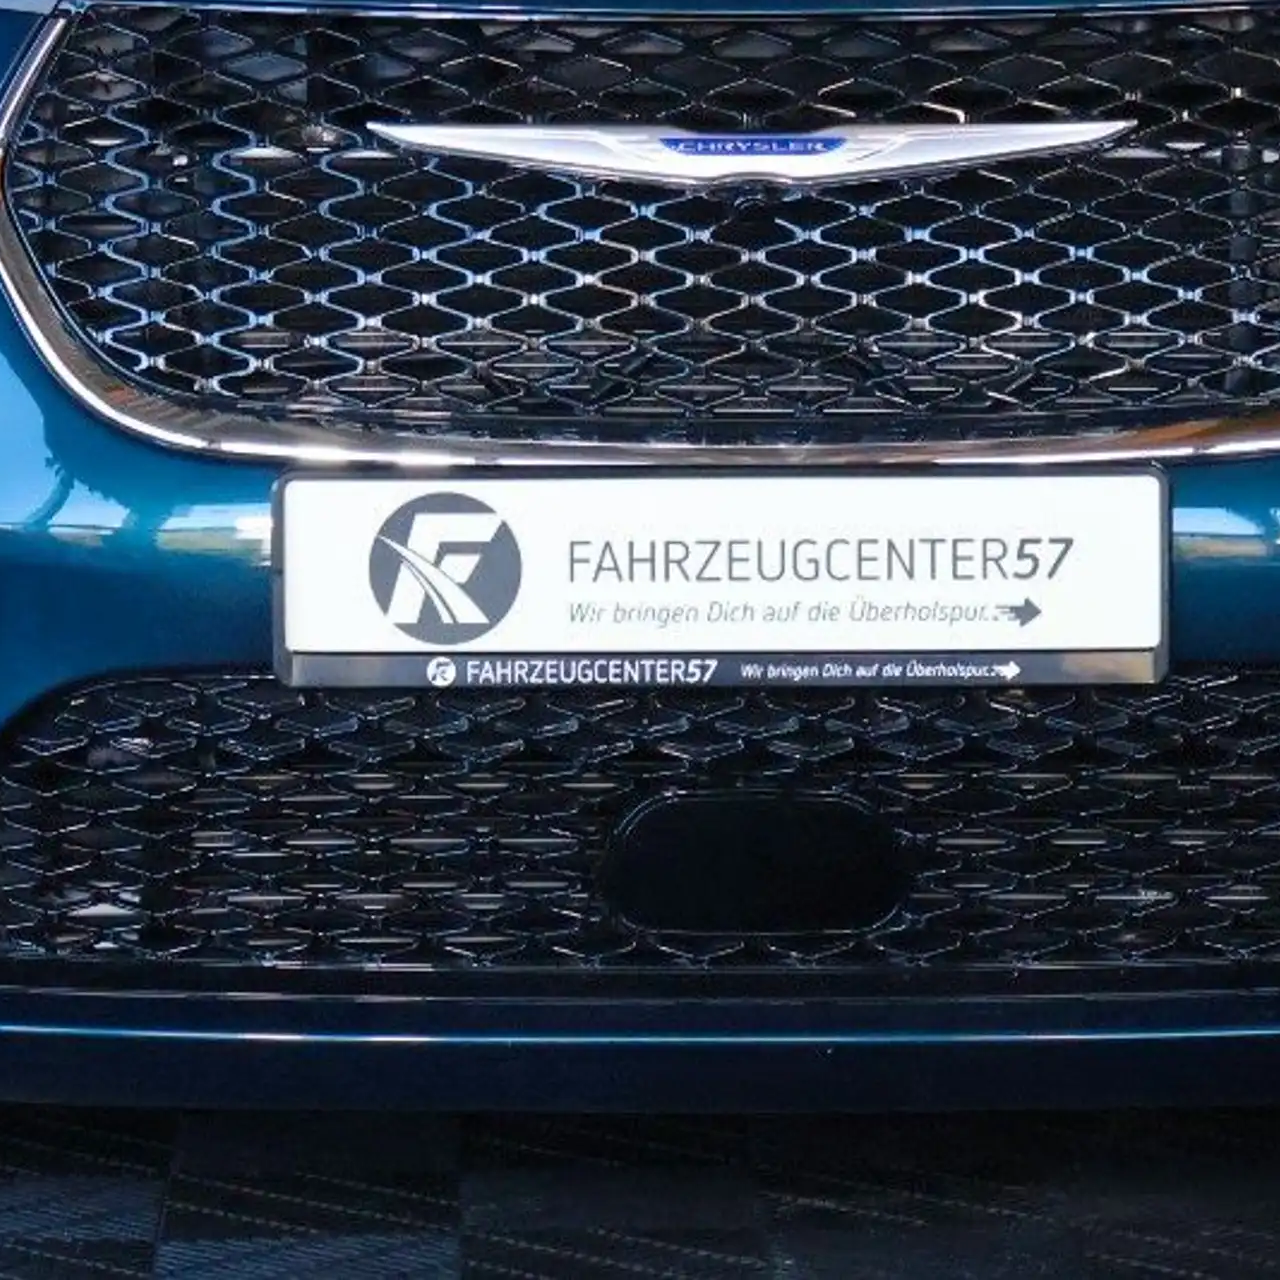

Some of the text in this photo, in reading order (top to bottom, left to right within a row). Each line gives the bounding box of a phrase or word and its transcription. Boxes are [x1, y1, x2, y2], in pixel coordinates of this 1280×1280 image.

[677, 140, 827, 153] CHRYSLER
[569, 537, 1075, 583] FAHRZEUGCENTER57
[569, 602, 608, 623] Wir
[613, 602, 699, 629] bringen
[707, 600, 755, 623] Dich
[763, 600, 801, 623] auf
[808, 600, 841, 622] die
[466, 658, 718, 685] FAHRZEUGCENTER57
[740, 662, 763, 678] Wir
[767, 662, 819, 681] bringen
[822, 662, 852, 678] Dich
[856, 662, 880, 678] auf
[882, 661, 904, 677] die
